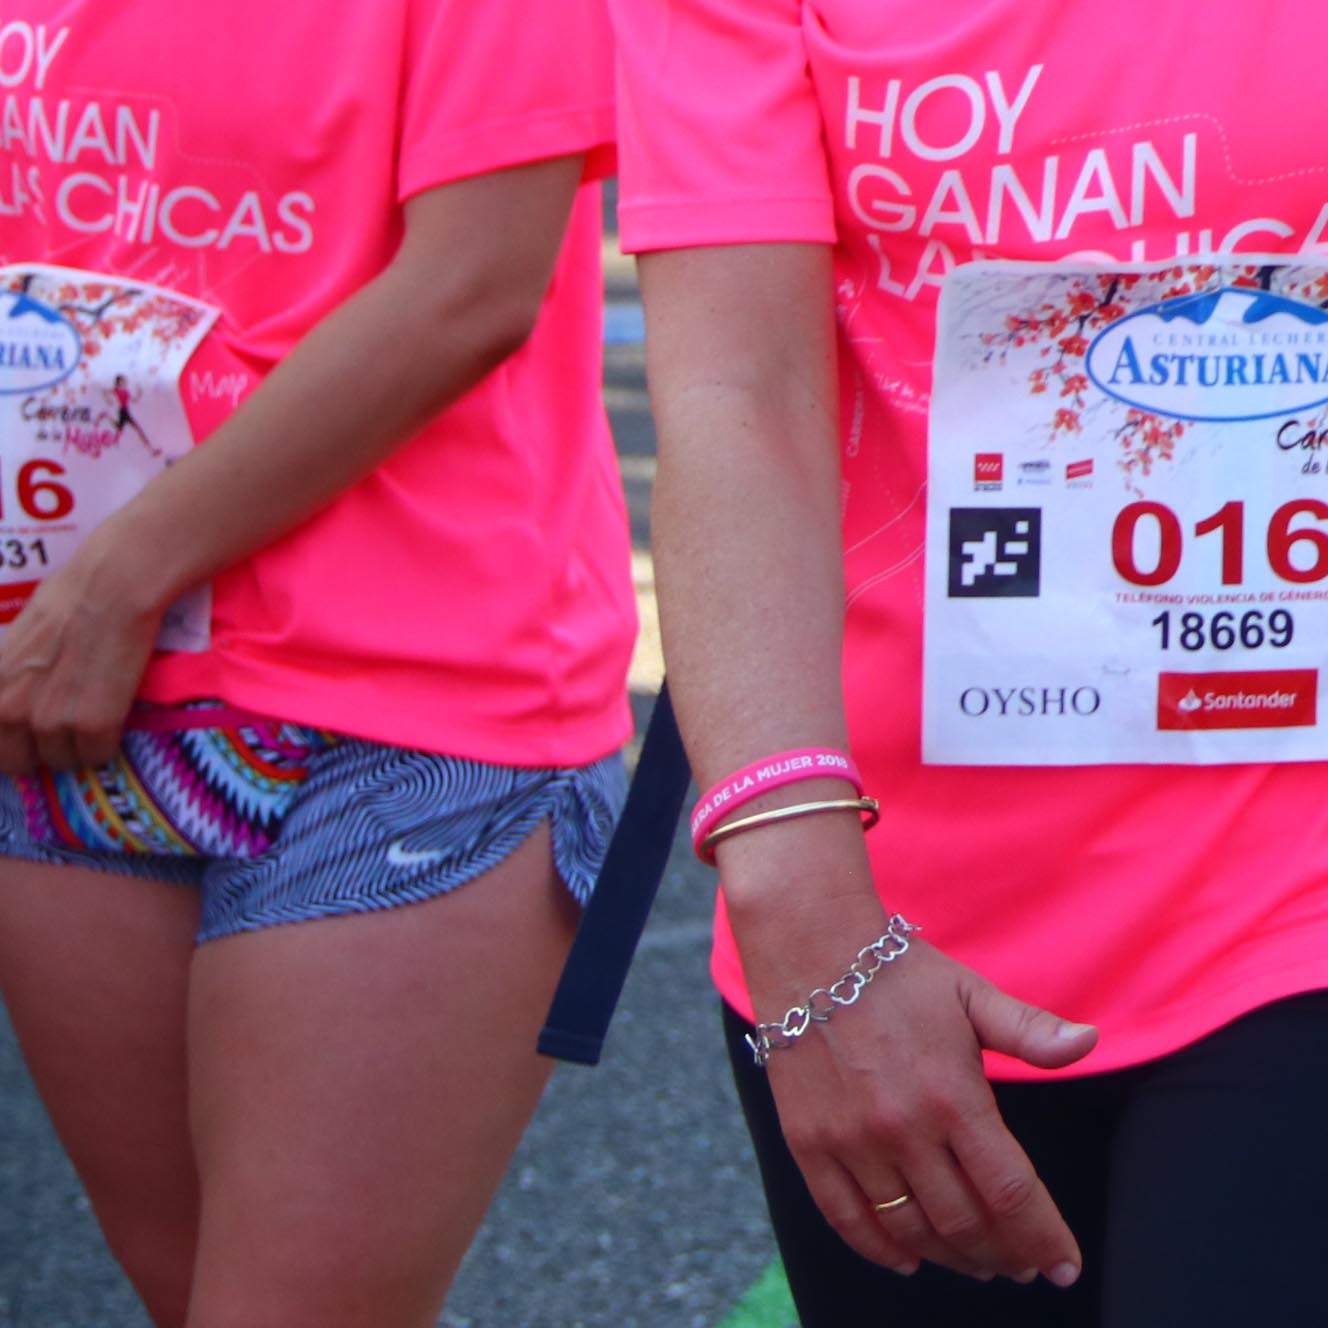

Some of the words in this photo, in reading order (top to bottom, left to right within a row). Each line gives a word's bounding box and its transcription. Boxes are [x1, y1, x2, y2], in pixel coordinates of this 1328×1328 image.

[845, 63, 1044, 161] HOY
[847, 133, 1198, 247] GANAN
[56, 171, 316, 254] CHICAS
[1152, 332, 1240, 347] CENTRAL
[21, 396, 92, 421] Carrera
[1302, 452, 1321, 474] de
[1114, 590, 1184, 605] TELÉFONO
[1187, 592, 1256, 604] VIOLENCIA
[1151, 609, 1295, 651] 18669
[959, 686, 1101, 717] OYSHO
[1203, 690, 1298, 711] Santander
[713, 785, 732, 808] DE
[732, 775, 754, 794] LA
[755, 756, 813, 783] MUJER
[816, 753, 849, 769] 2018
